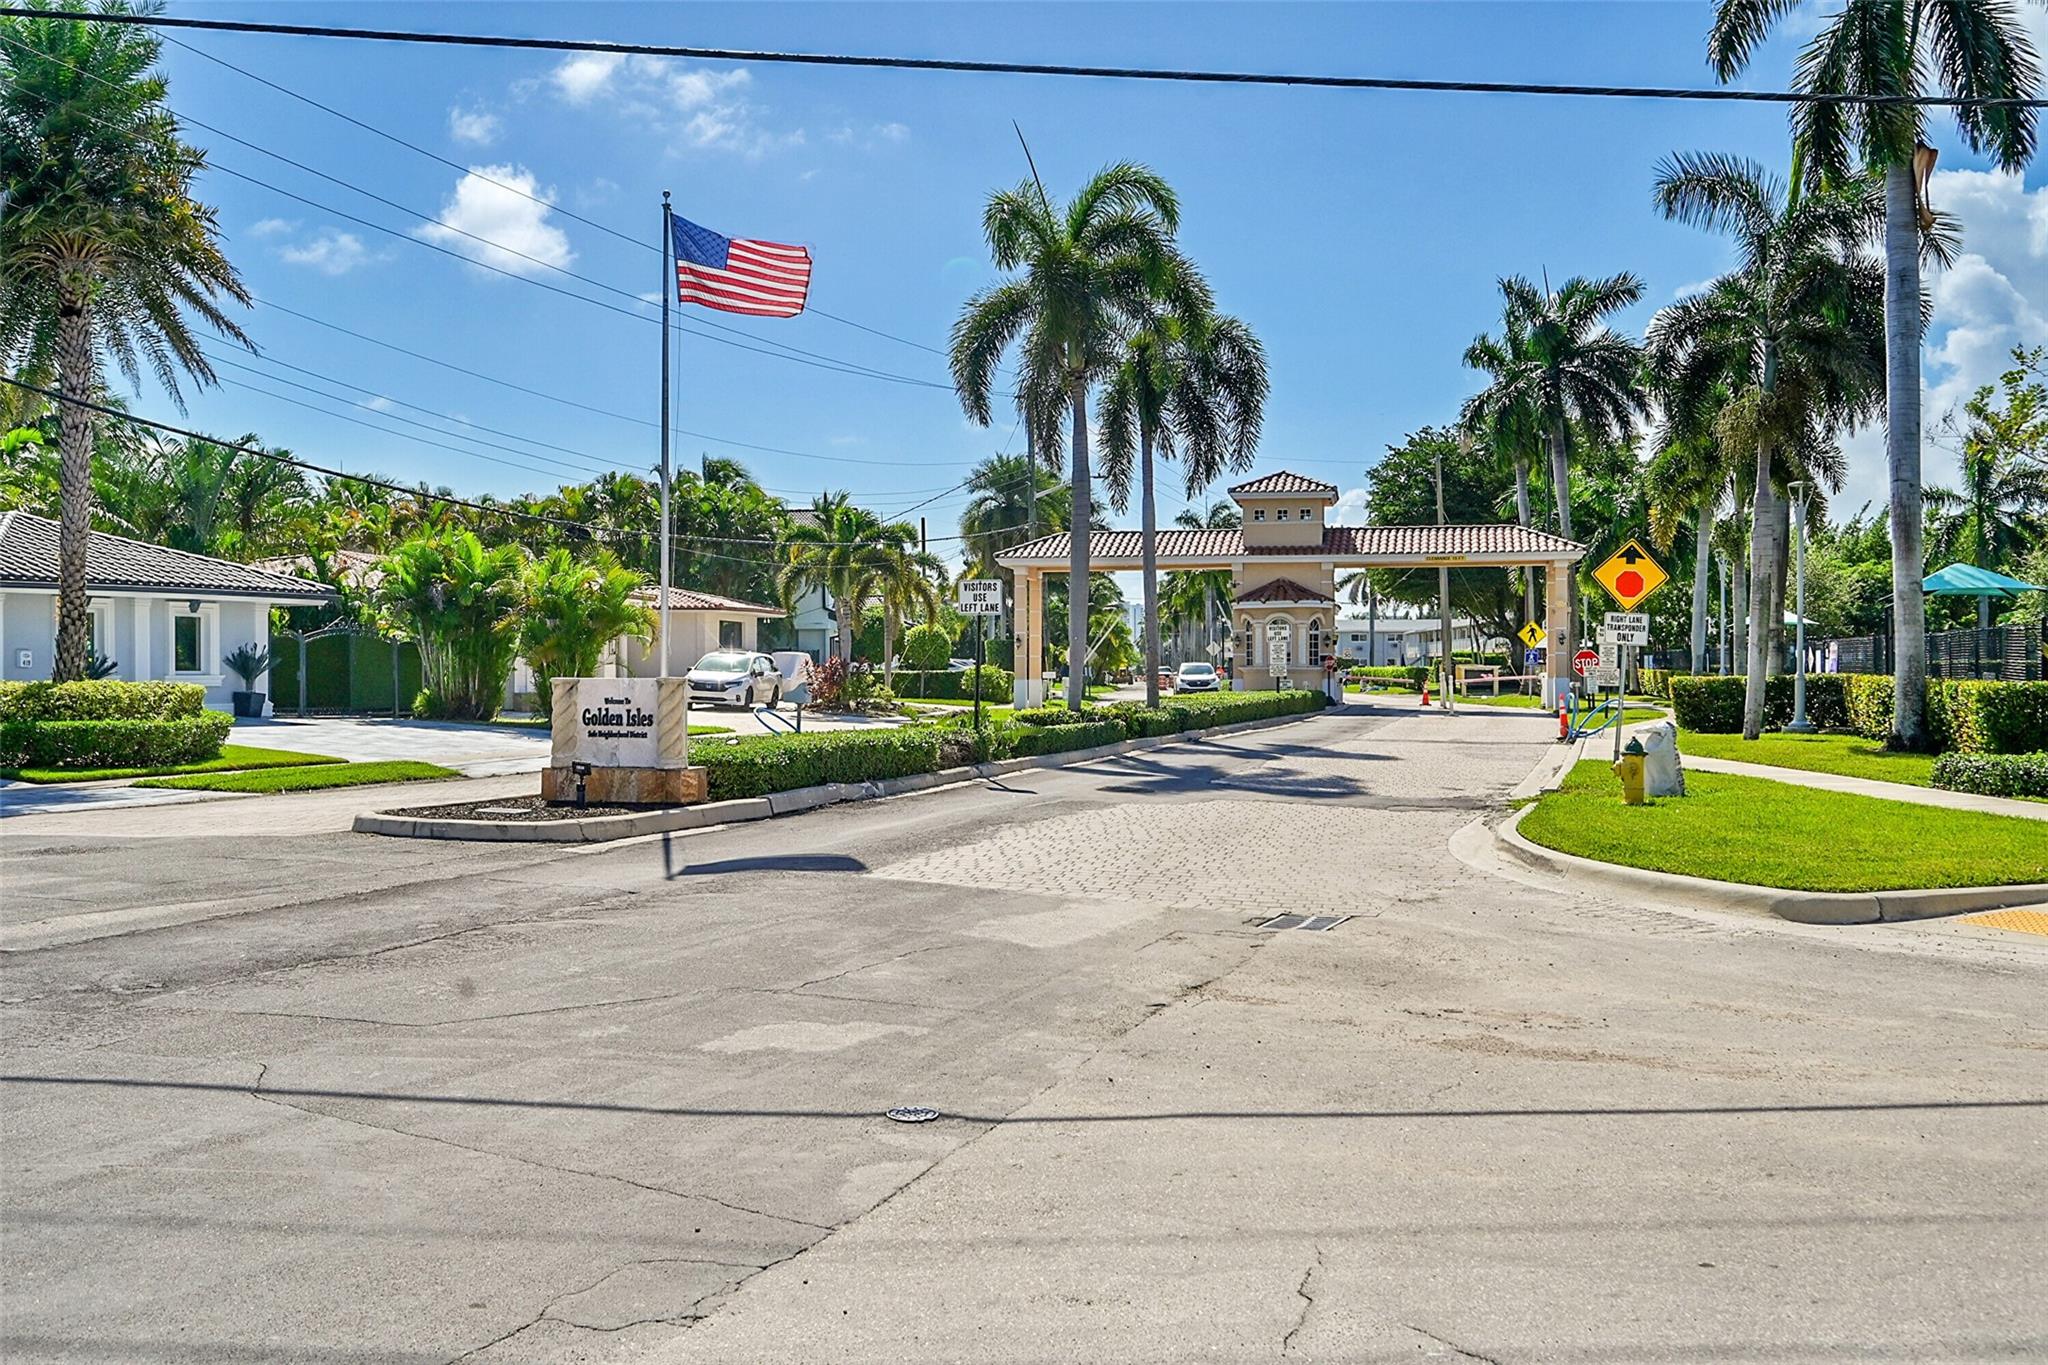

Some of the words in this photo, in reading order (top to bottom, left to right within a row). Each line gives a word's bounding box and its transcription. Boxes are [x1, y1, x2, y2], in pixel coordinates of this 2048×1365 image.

[964, 582, 997, 591] VISITORS
[973, 593, 987, 602] USE
[960, 603, 977, 612] LEFT
[980, 603, 999, 612] LANE
[1611, 615, 1626, 623] RIGHT
[1607, 623, 1646, 632] TRANSPONDER
[1617, 632, 1634, 642] ONLY
[1575, 658, 1598, 669] STOP
[582, 707, 623, 726] Golden
[626, 707, 653, 726] Isles
